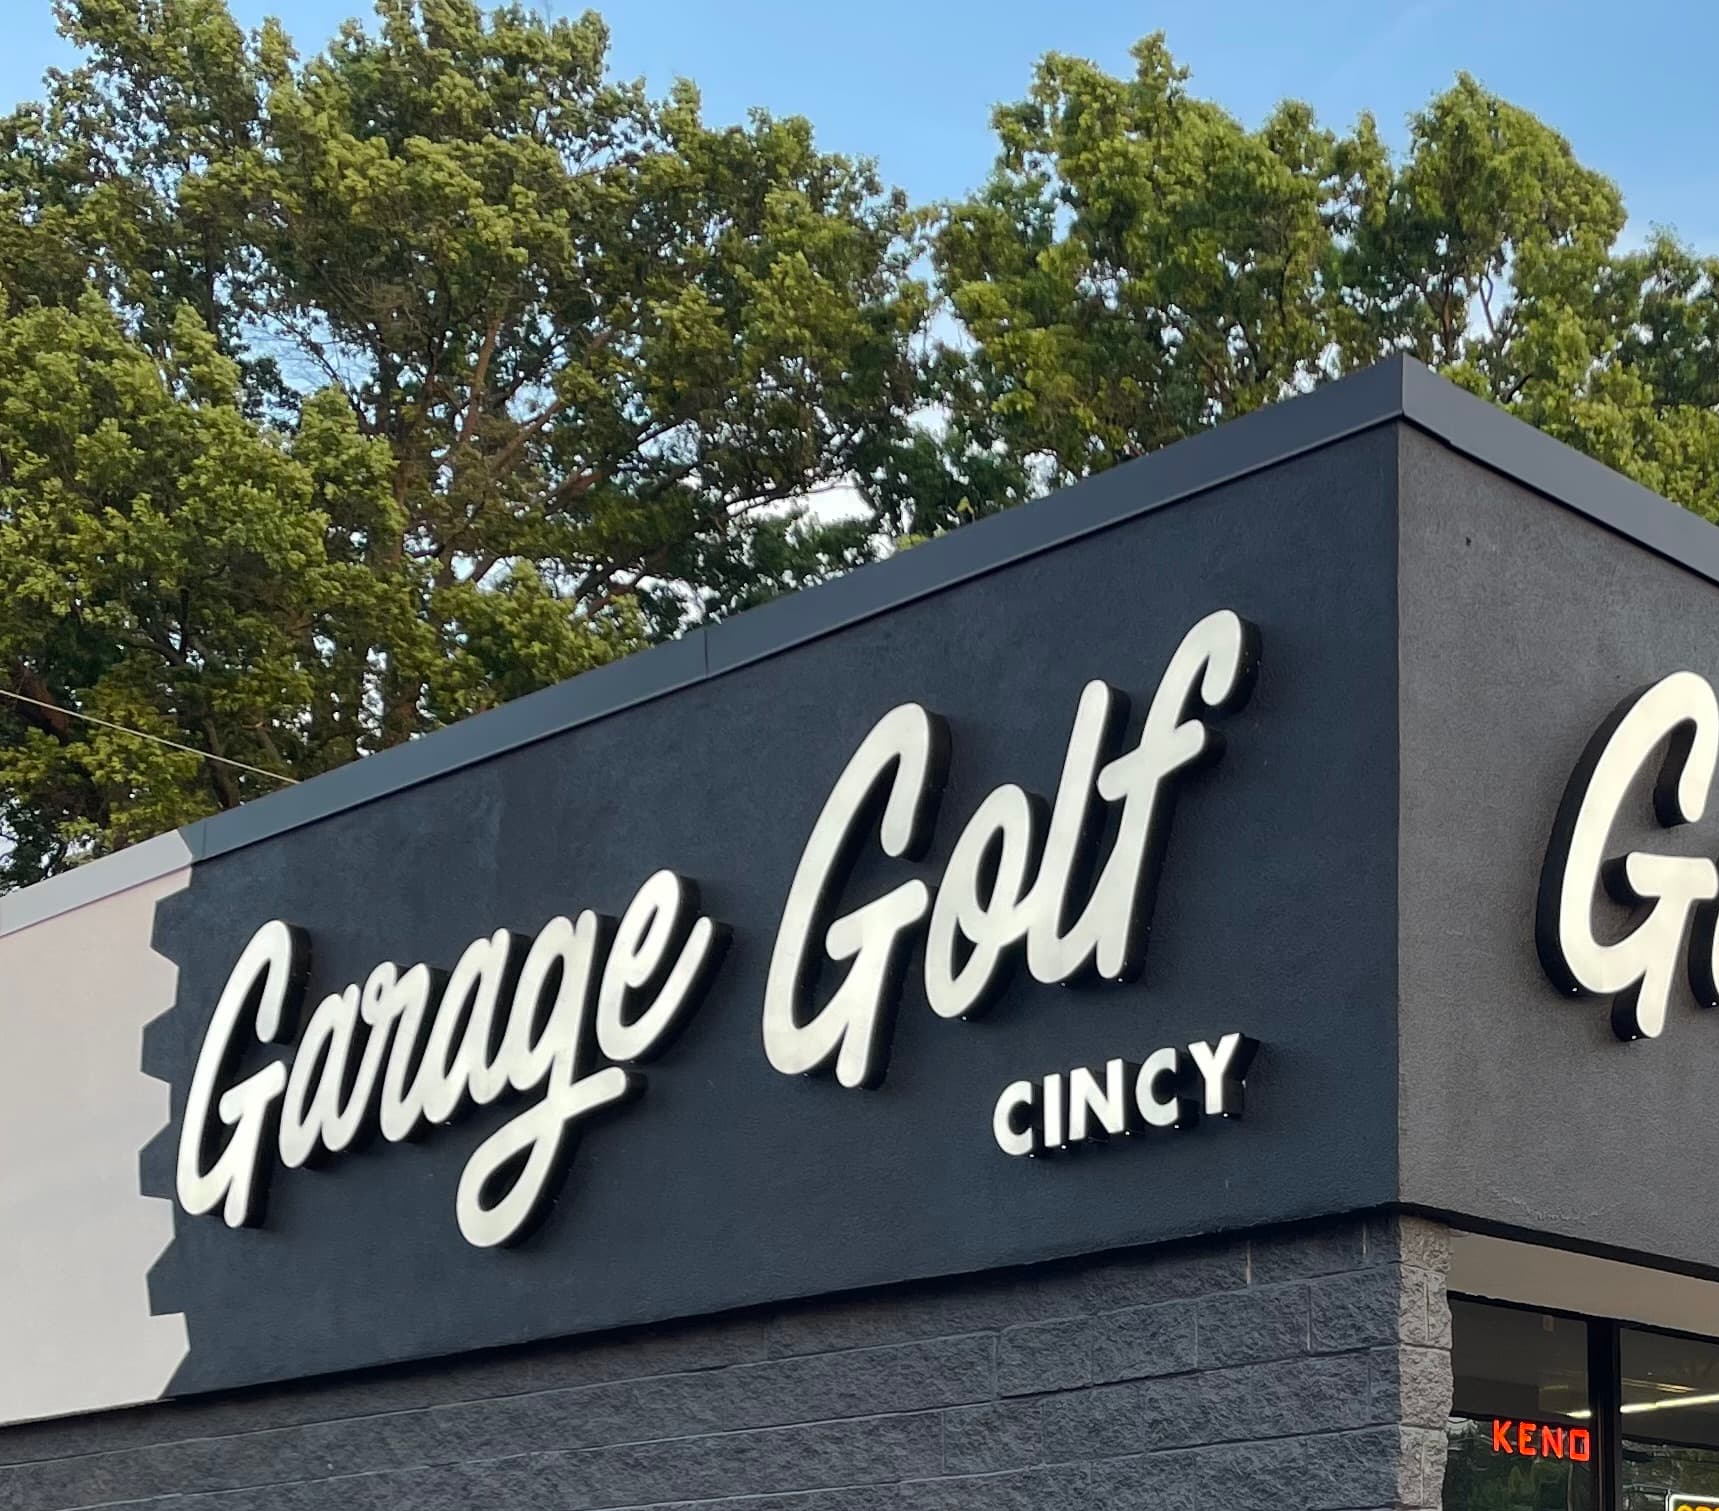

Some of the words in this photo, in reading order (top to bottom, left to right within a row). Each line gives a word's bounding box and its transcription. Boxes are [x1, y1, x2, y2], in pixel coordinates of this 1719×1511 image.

[177, 870, 712, 1247] Garage
[763, 610, 1241, 1087] Golf
[994, 1033, 1239, 1155] CINCY
[1493, 1419, 1590, 1462] KENO
